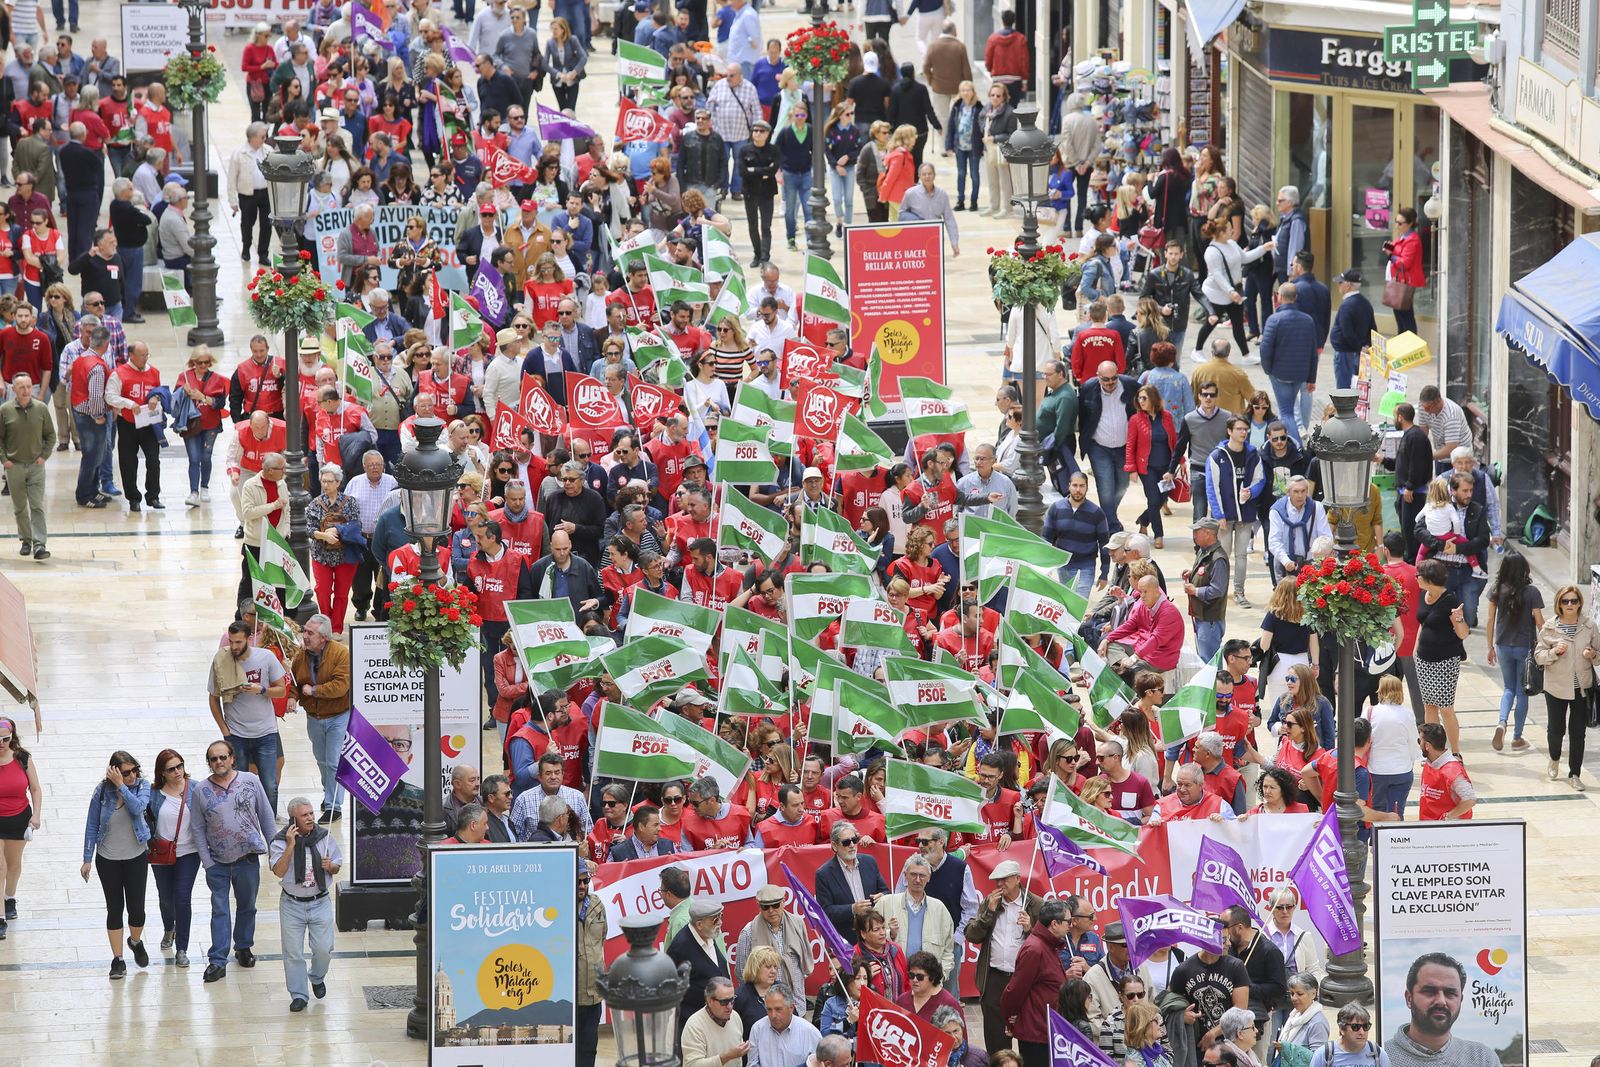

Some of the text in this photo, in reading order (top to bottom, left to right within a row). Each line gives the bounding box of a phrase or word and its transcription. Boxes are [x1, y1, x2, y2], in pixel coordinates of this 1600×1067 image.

[1520, 75, 1556, 125] FARMACIA
[315, 210, 354, 232] SERVI
[863, 249, 927, 261] BRILLAR ES HACER
[865, 260, 925, 271] BRILLAR A OTROS
[1082, 335, 1115, 348] LIVERPOOL
[1524, 321, 1543, 352] SUR
[1402, 350, 1425, 365] ONCE
[353, 361, 372, 378] PSO
[579, 385, 612, 403] UGT
[808, 391, 834, 413] UGT
[1577, 382, 1600, 409] Diar
[920, 403, 949, 415] PSOE
[736, 447, 758, 459] PSOE
[740, 520, 765, 545] PSOE
[486, 583, 504, 592] PSOE
[874, 607, 900, 623] PSO
[1034, 603, 1063, 624] PSOE
[537, 628, 568, 643] PSOE
[364, 670, 407, 680] ACABAR
[408, 670, 425, 679] CO
[364, 682, 409, 692] ESTIGMA
[918, 688, 946, 703] PSOE
[364, 694, 399, 704] SALUD
[632, 741, 669, 755] PSOE
[357, 777, 379, 801] Málaga
[915, 794, 953, 805] Andalucía
[914, 801, 953, 820] PSOE
[467, 863, 543, 874] 28 DE ABRIL DE 2018
[1251, 867, 1292, 884] Mála
[1391, 862, 1490, 874] “LA AUTOESTIMA
[612, 859, 751, 918] 1 de AYO
[1391, 875, 1491, 888] Y EL EMPLEO SON
[474, 889, 536, 906] FESTIVAL
[1391, 888, 1505, 901] CLAVE PARA EVITAR
[1322, 880, 1329, 891] la
[1327, 890, 1357, 939] ciudadanía
[1392, 900, 1480, 914] LA EXCLUSIÓN”
[1157, 914, 1210, 930] CCOO
[1325, 903, 1348, 942] Andalucía
[494, 957, 533, 978] Soles de
[494, 973, 540, 995] Málaga
[1196, 972, 1206, 983] OF
[1208, 972, 1234, 996] ANARCH
[1471, 979, 1506, 999] Soles de
[1471, 994, 1514, 1015] Málaga
[872, 1012, 918, 1057] UGT
